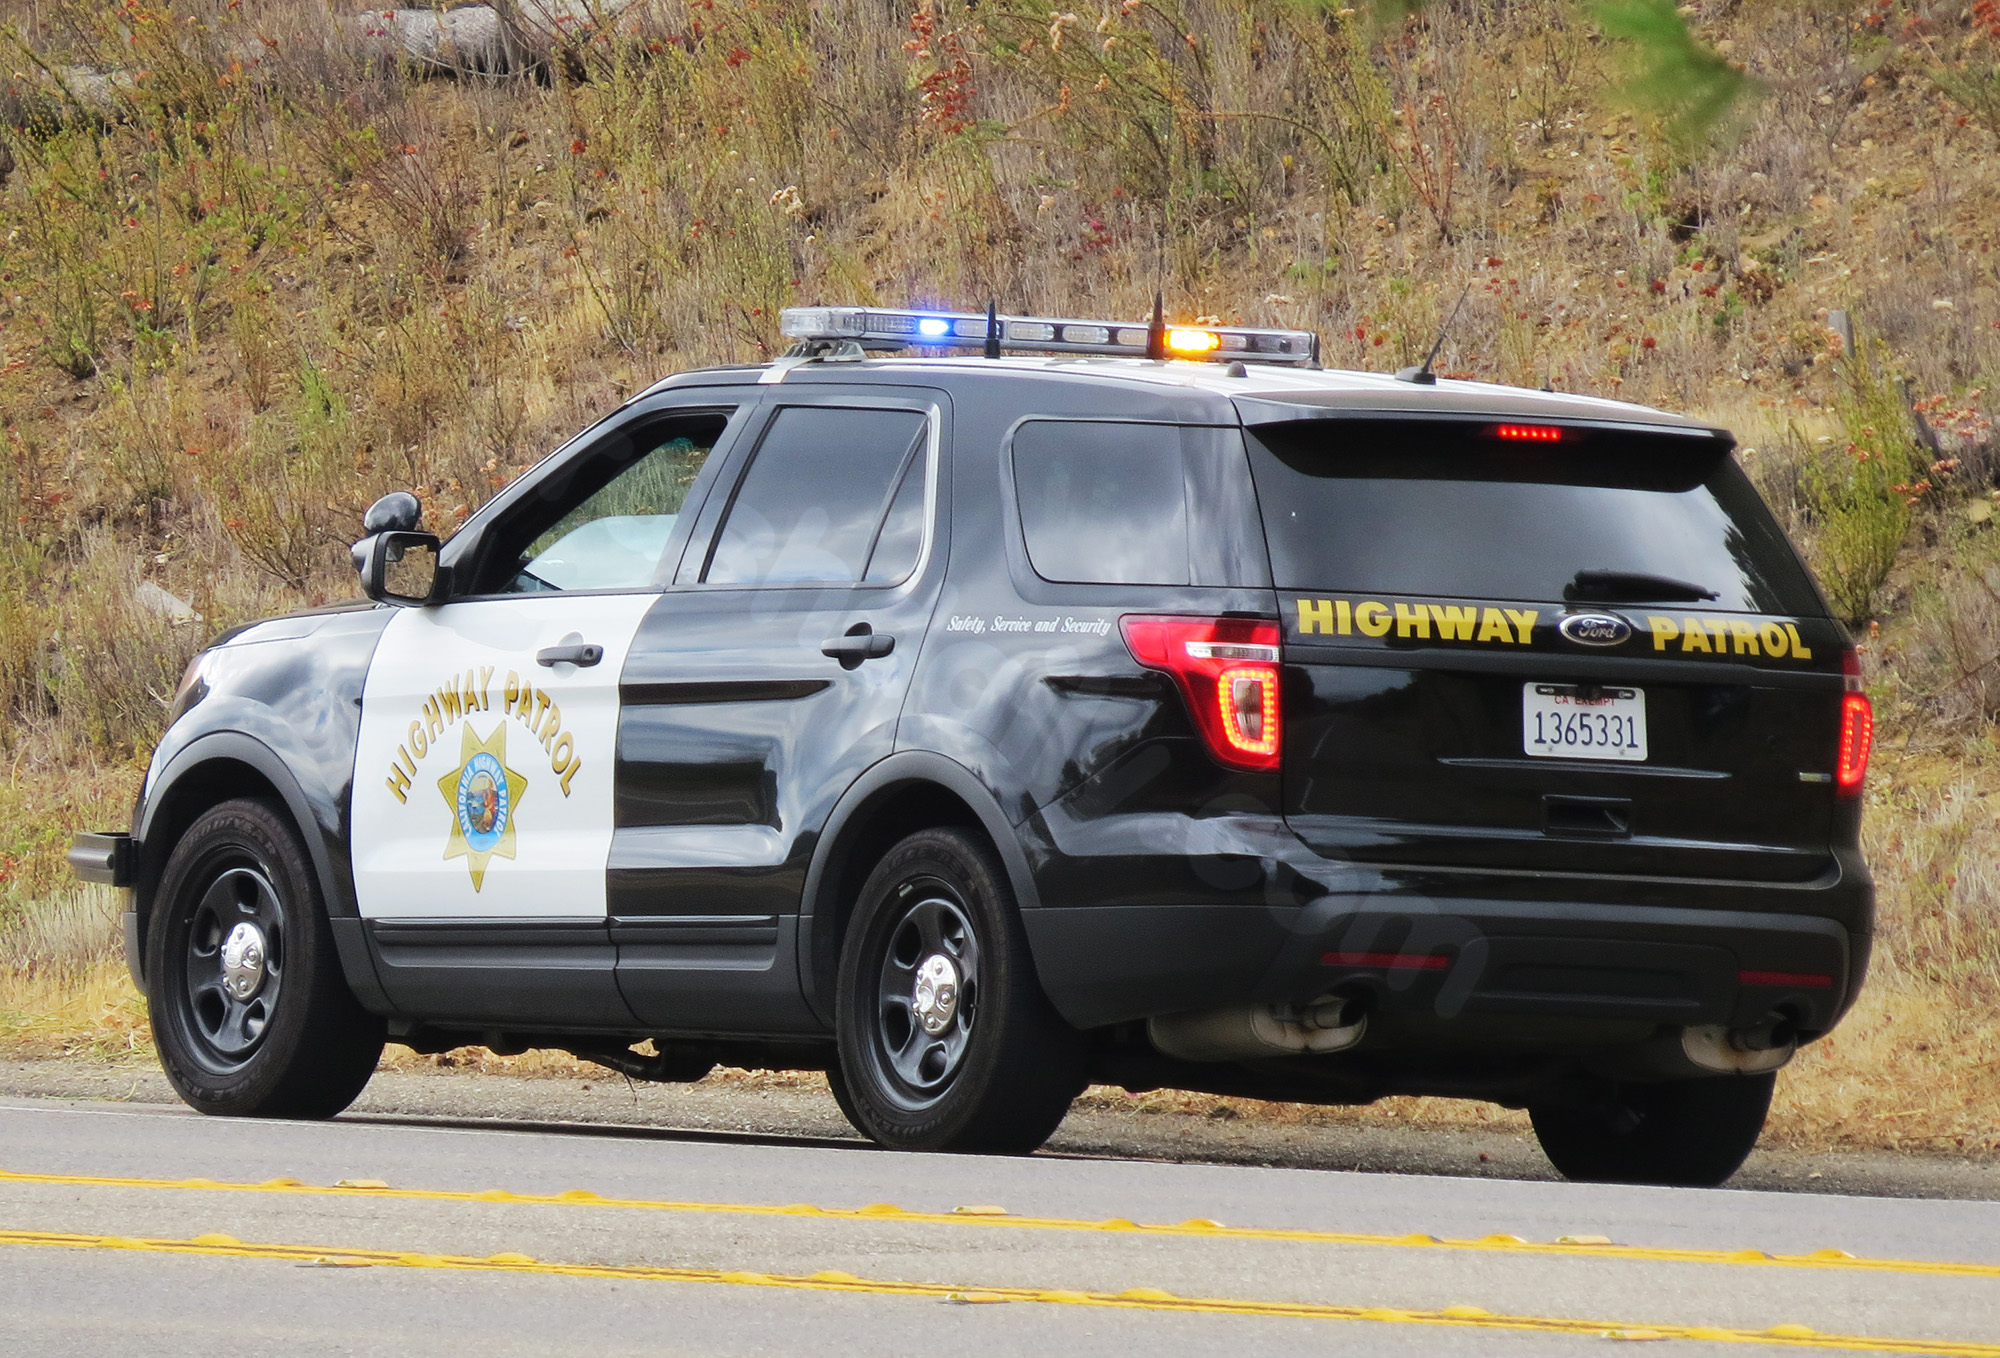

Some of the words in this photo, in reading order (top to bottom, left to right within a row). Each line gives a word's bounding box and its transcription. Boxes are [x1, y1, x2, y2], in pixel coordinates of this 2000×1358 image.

[947, 616, 986, 634] Safety,
[990, 616, 1031, 633] Service
[1034, 617, 1060, 633] and
[1061, 617, 1112, 636] Security
[1297, 599, 1539, 645] HIGHWAY
[1647, 615, 1812, 660] PATROL
[1578, 619, 1617, 639] Ford
[1554, 695, 1569, 704] CA
[385, 666, 494, 804] HIGHWAY
[504, 670, 581, 798] PATROL
[1534, 711, 1639, 748] 1365331
